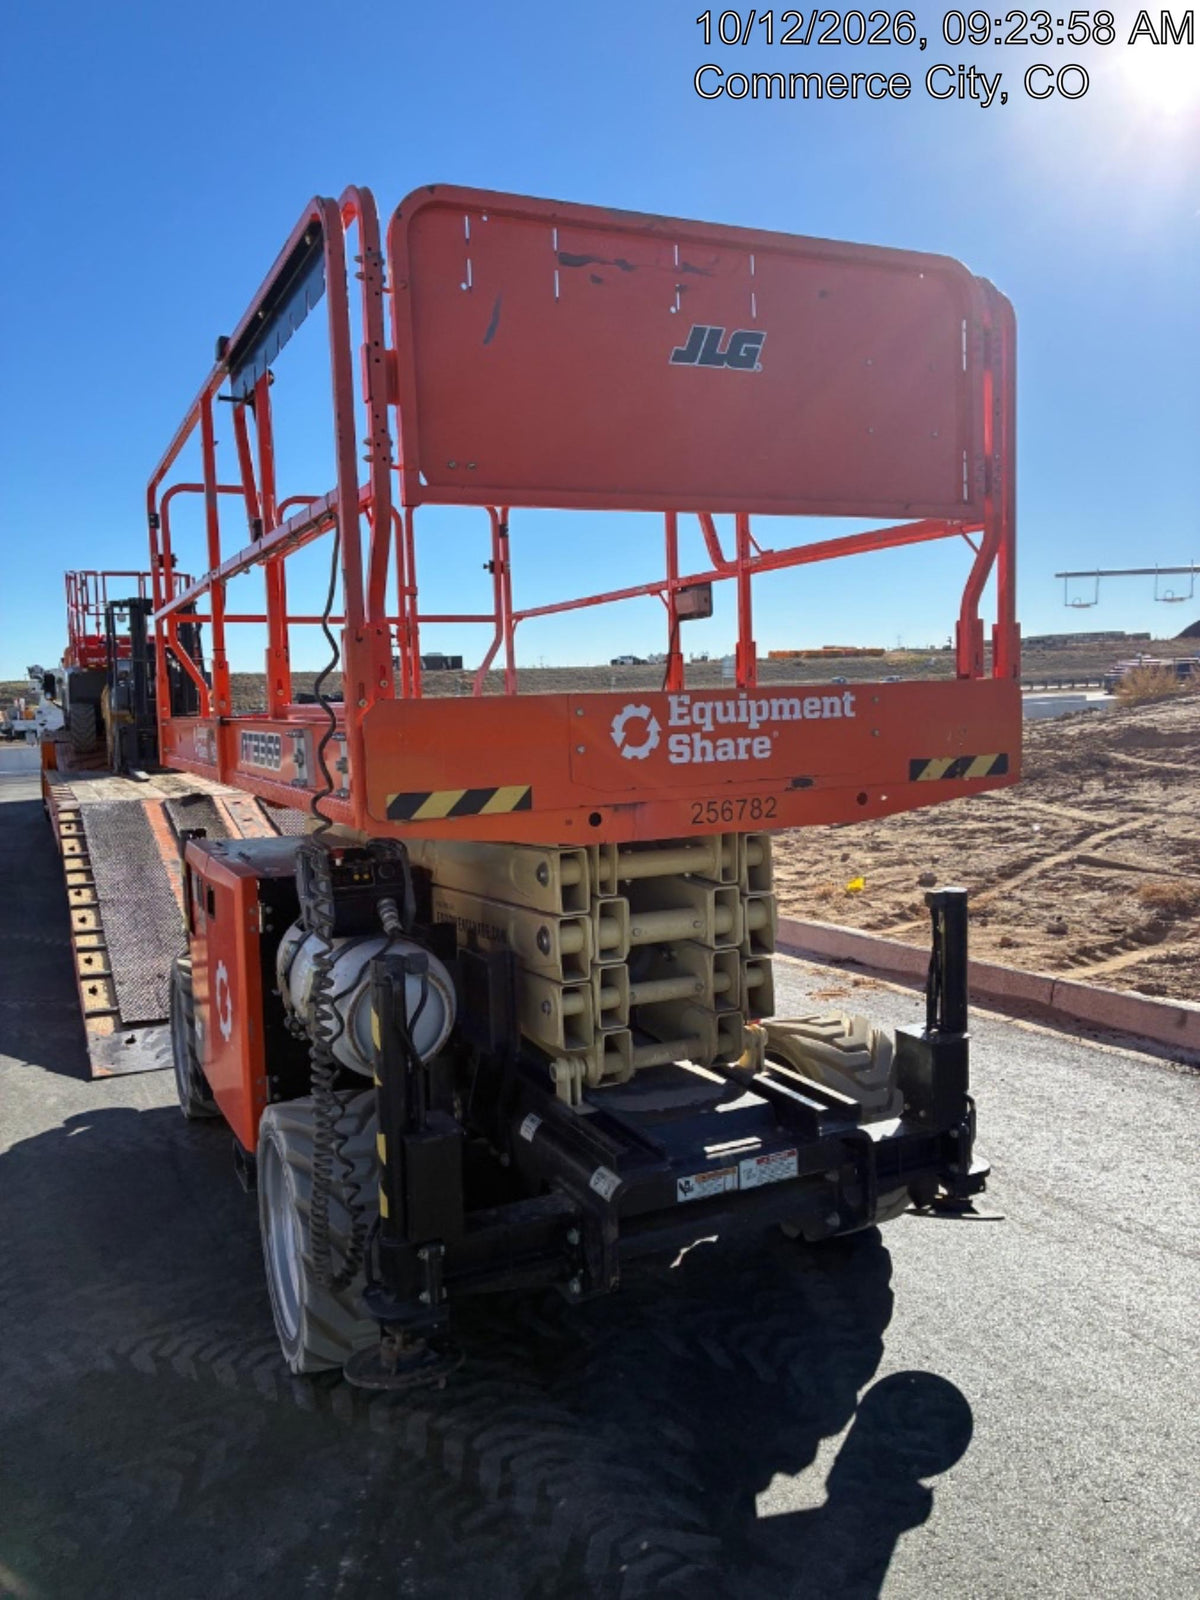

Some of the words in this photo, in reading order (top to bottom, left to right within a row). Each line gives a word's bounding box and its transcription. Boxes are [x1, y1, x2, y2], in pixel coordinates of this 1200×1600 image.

[668, 323, 767, 372] JLG
[668, 691, 857, 732] Equipment
[668, 732, 773, 765] Share
[690, 796, 779, 826] 256782
